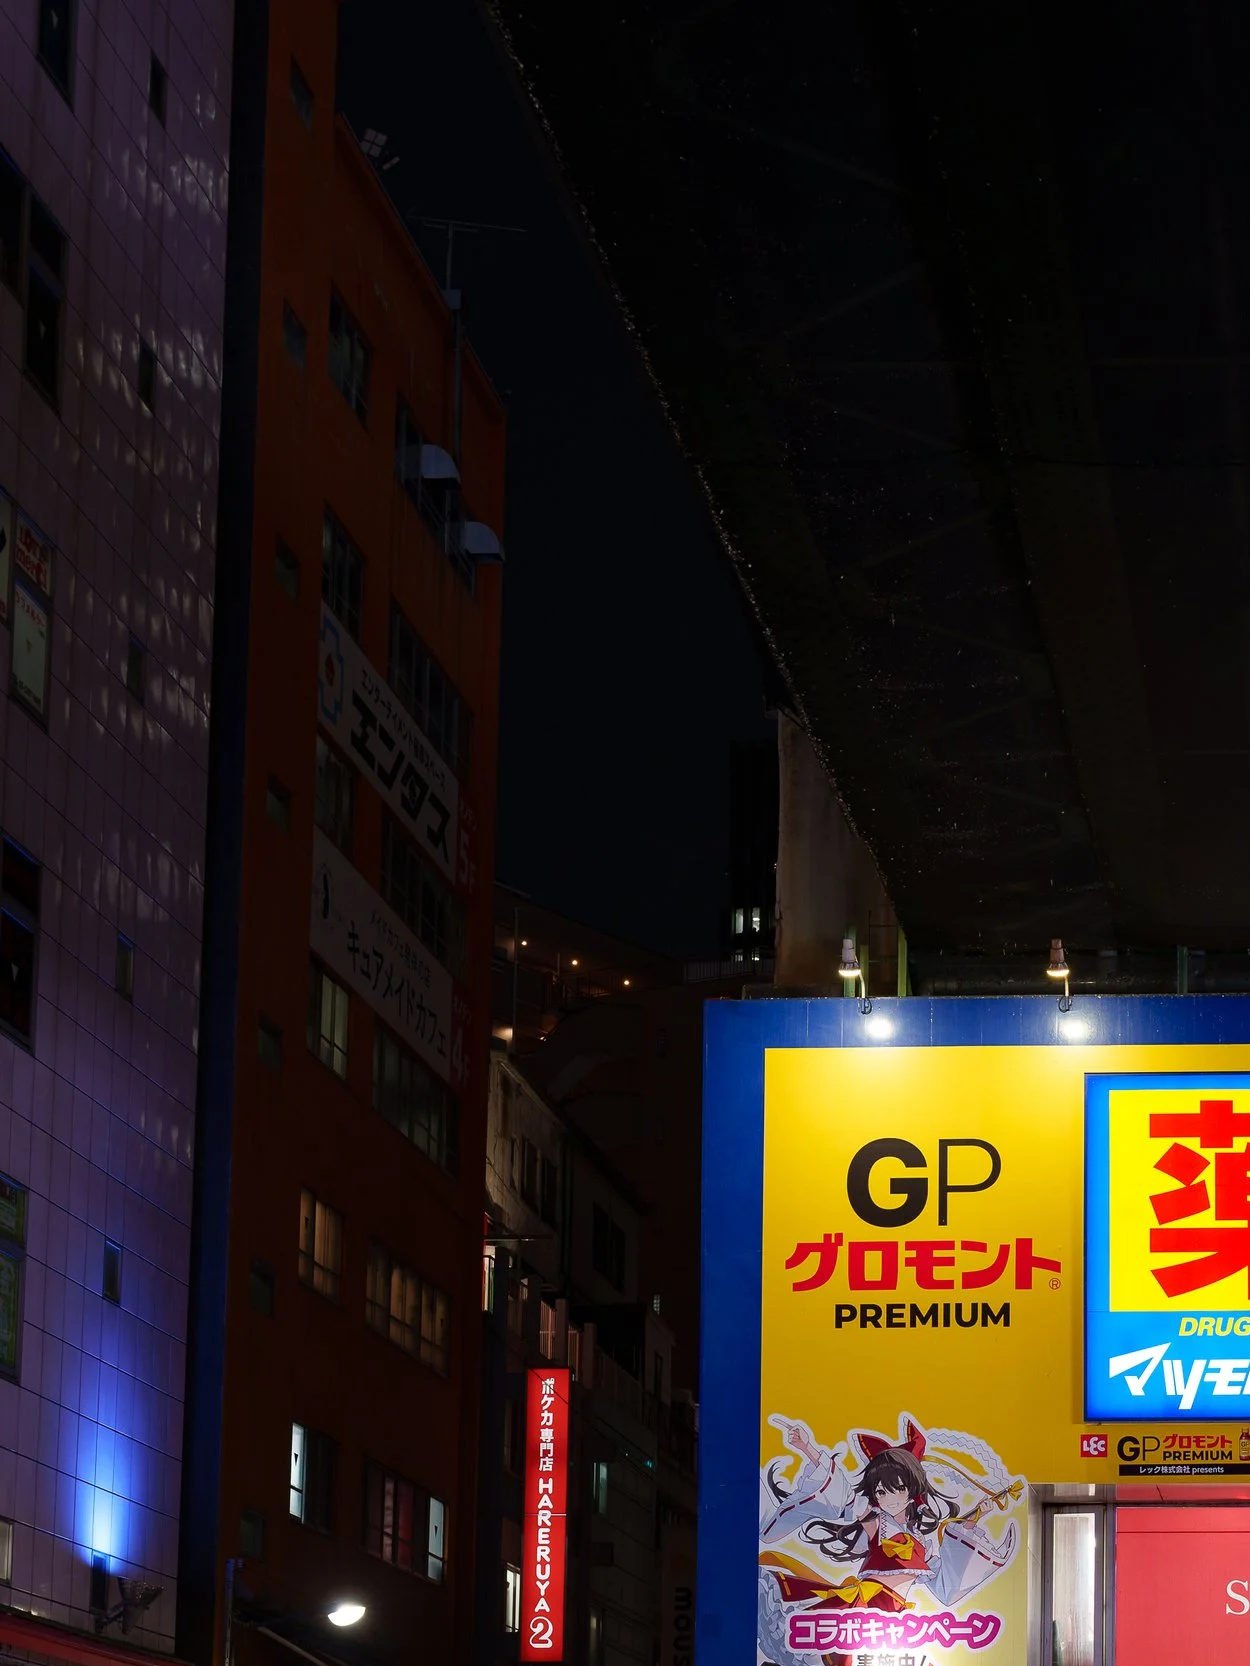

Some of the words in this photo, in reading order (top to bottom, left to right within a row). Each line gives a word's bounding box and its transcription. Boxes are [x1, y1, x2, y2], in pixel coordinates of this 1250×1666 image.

[348, 920, 446, 1057] キュアメイドカフェ
[847, 1138, 1002, 1228] GP
[834, 1303, 1011, 1329] PREMIUM
[540, 1378, 555, 1472] ポケカ専門店
[1117, 1436, 1160, 1461] GP
[1162, 1434, 1232, 1449] グロモント
[1163, 1449, 1232, 1461] PREMIUM
[1140, 1466, 1191, 1475] レック株式会社
[1192, 1466, 1224, 1476] presents
[534, 1477, 553, 1612] HARERUYA
[530, 1616, 553, 1648] 2
[795, 1617, 995, 1645] コラボキャンペーン
